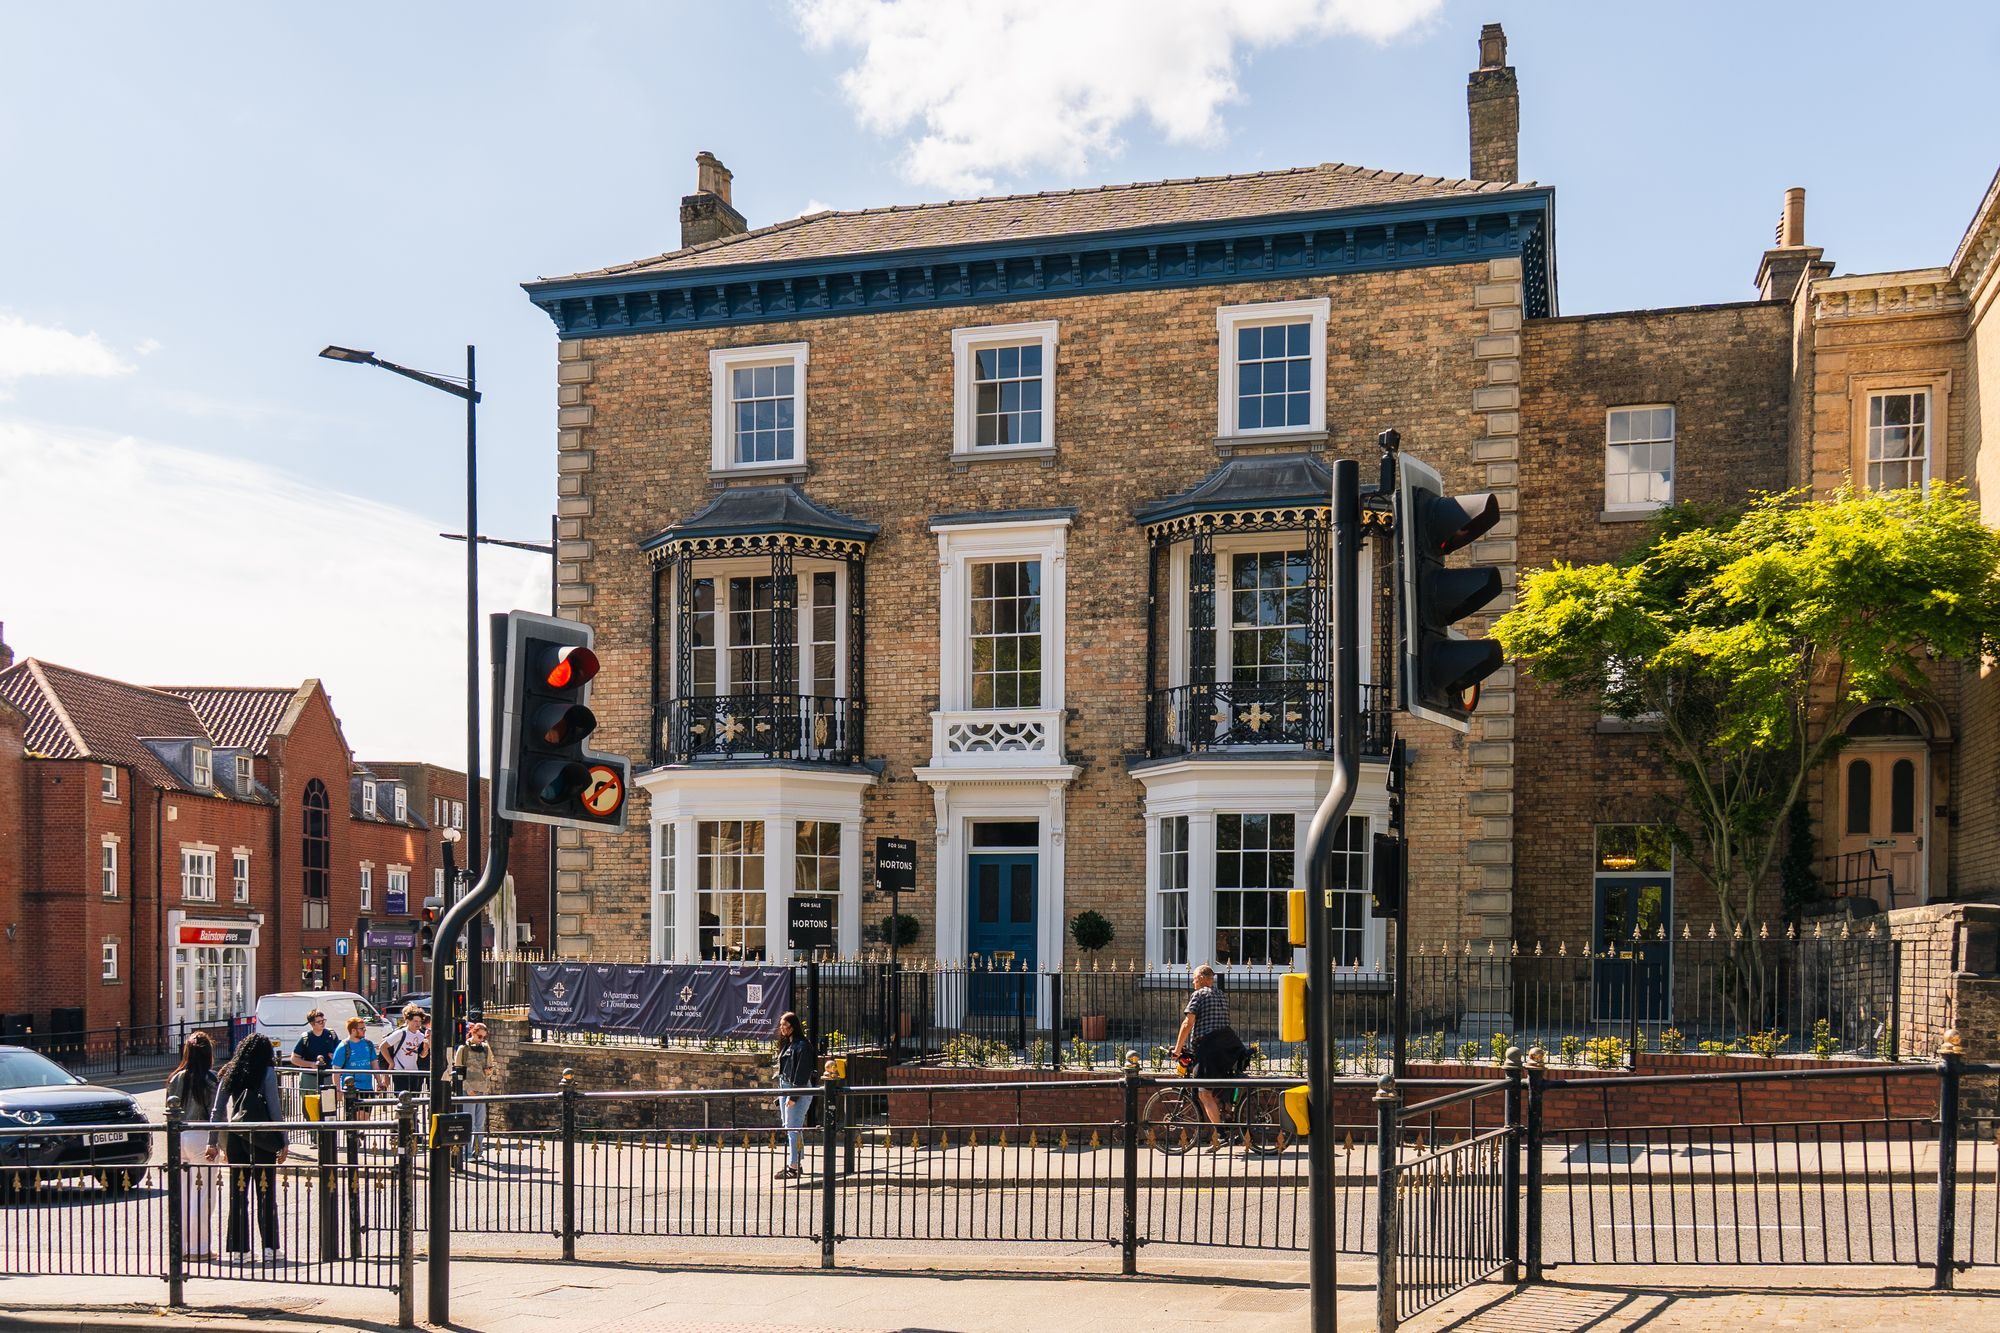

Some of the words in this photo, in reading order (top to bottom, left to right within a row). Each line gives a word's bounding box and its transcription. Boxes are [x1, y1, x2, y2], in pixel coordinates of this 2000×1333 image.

[880, 860, 912, 870] HORTONS
[792, 919, 828, 928] HORTONS
[608, 991, 639, 1000] Apartments
[610, 1000, 641, 1009] Townhouse
[742, 1006, 766, 1016] Register
[736, 1015, 748, 1024] Your
[749, 1016, 772, 1025] Interest
[108, 1132, 123, 1142] COB
